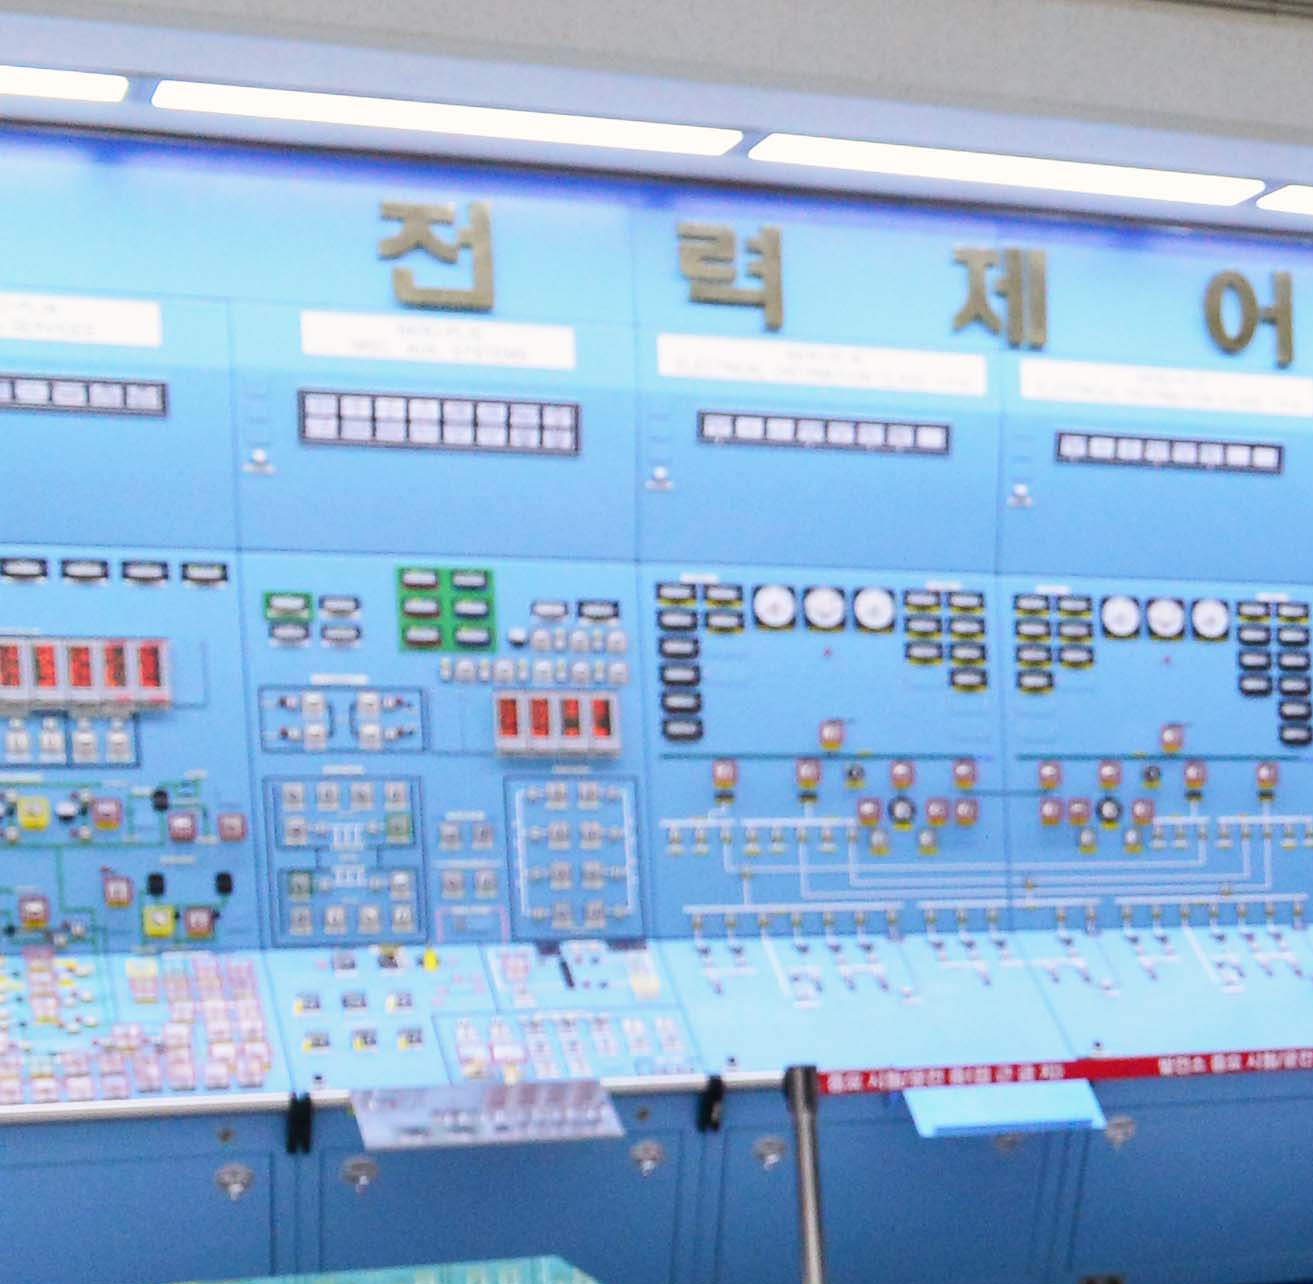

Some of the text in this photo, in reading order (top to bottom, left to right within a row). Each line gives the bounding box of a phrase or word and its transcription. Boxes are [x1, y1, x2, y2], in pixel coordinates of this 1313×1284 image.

[380, 200, 496, 312] 전
[676, 222, 784, 331] 력
[953, 247, 1048, 348] 제
[1203, 269, 1294, 369] 어
